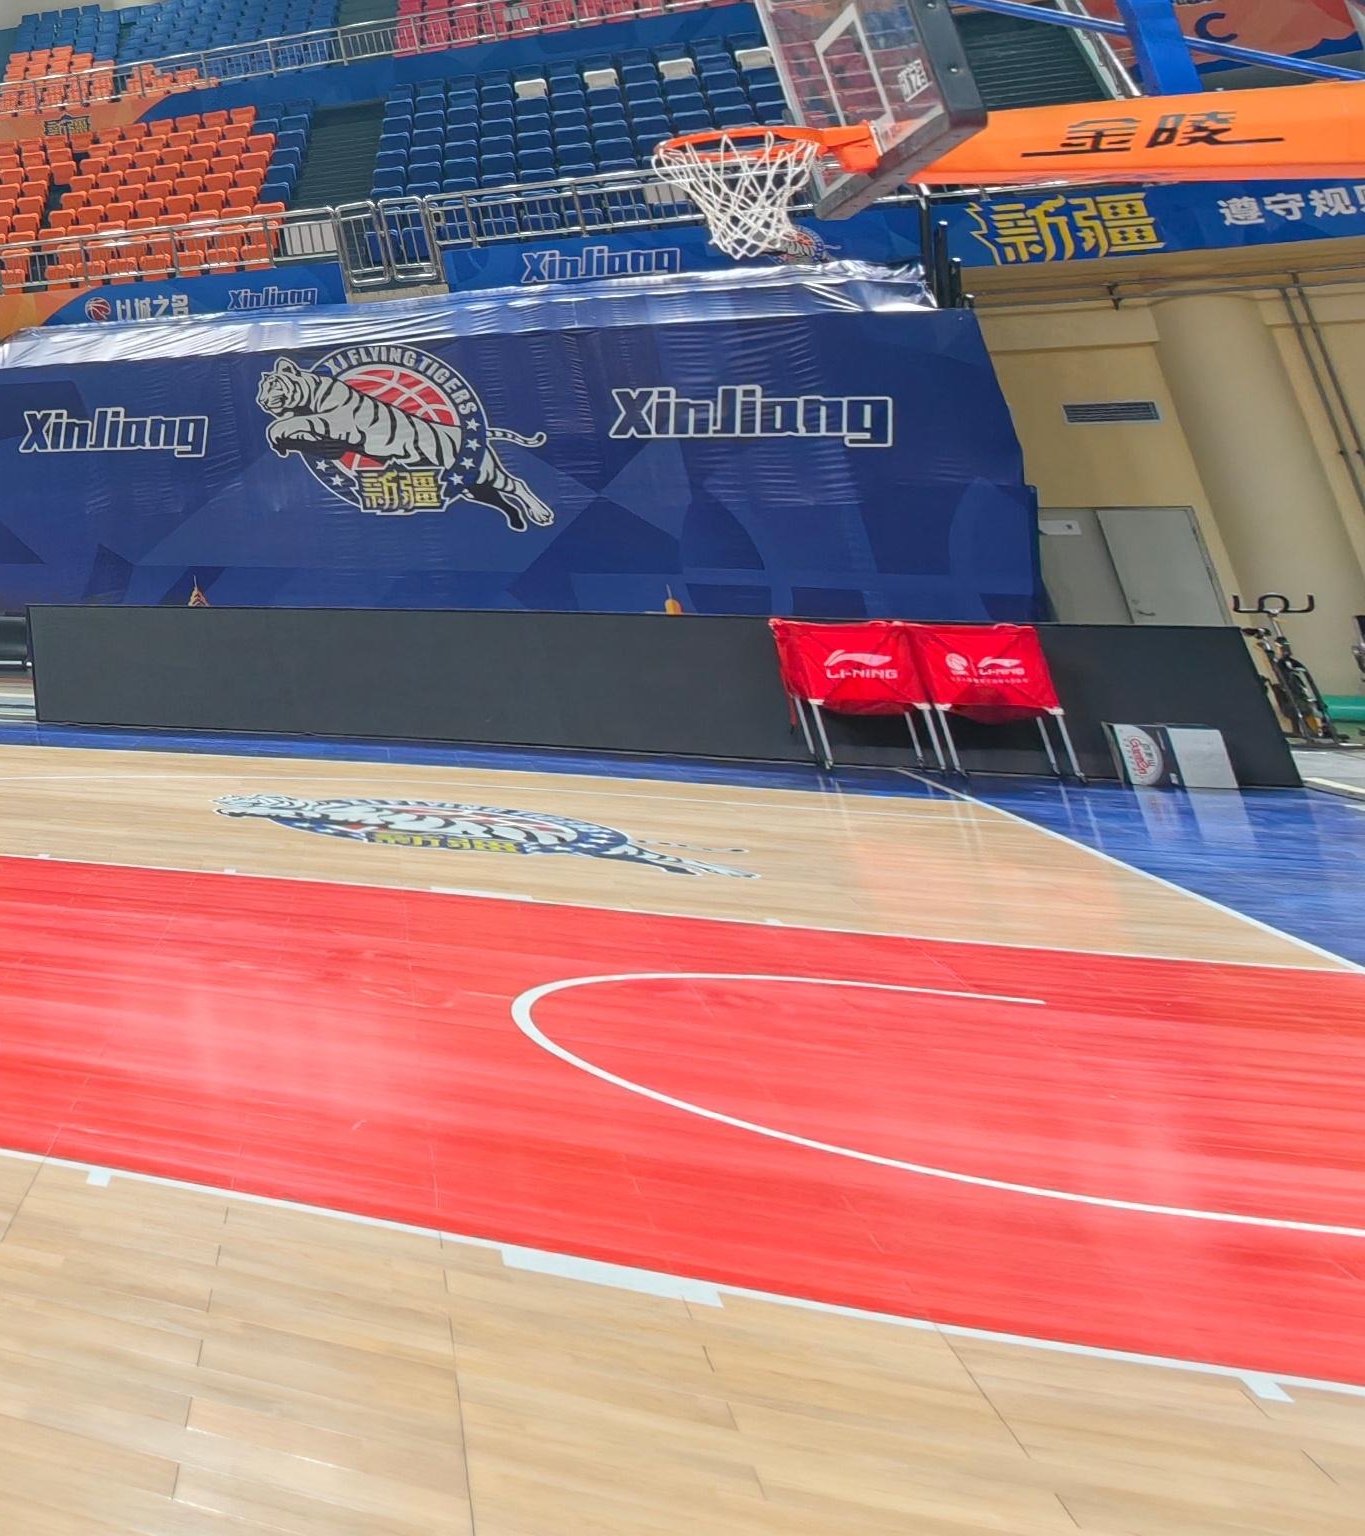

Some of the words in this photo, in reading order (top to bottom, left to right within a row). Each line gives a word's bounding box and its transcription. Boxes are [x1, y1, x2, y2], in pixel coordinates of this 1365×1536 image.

[1194, 12, 1238, 43] C
[1021, 111, 1285, 158] 金陵
[991, 194, 1166, 264] 新疆
[521, 246, 680, 284] XinJiang
[227, 286, 317, 311] XinJiang
[323, 353, 349, 376] XJ
[346, 346, 417, 367] FLYING
[415, 355, 478, 415] TIGERS
[19, 406, 208, 457] XinJiang
[609, 384, 893, 448] XinJiang
[360, 470, 442, 511] 新疆
[826, 668, 898, 680] LI-NING
